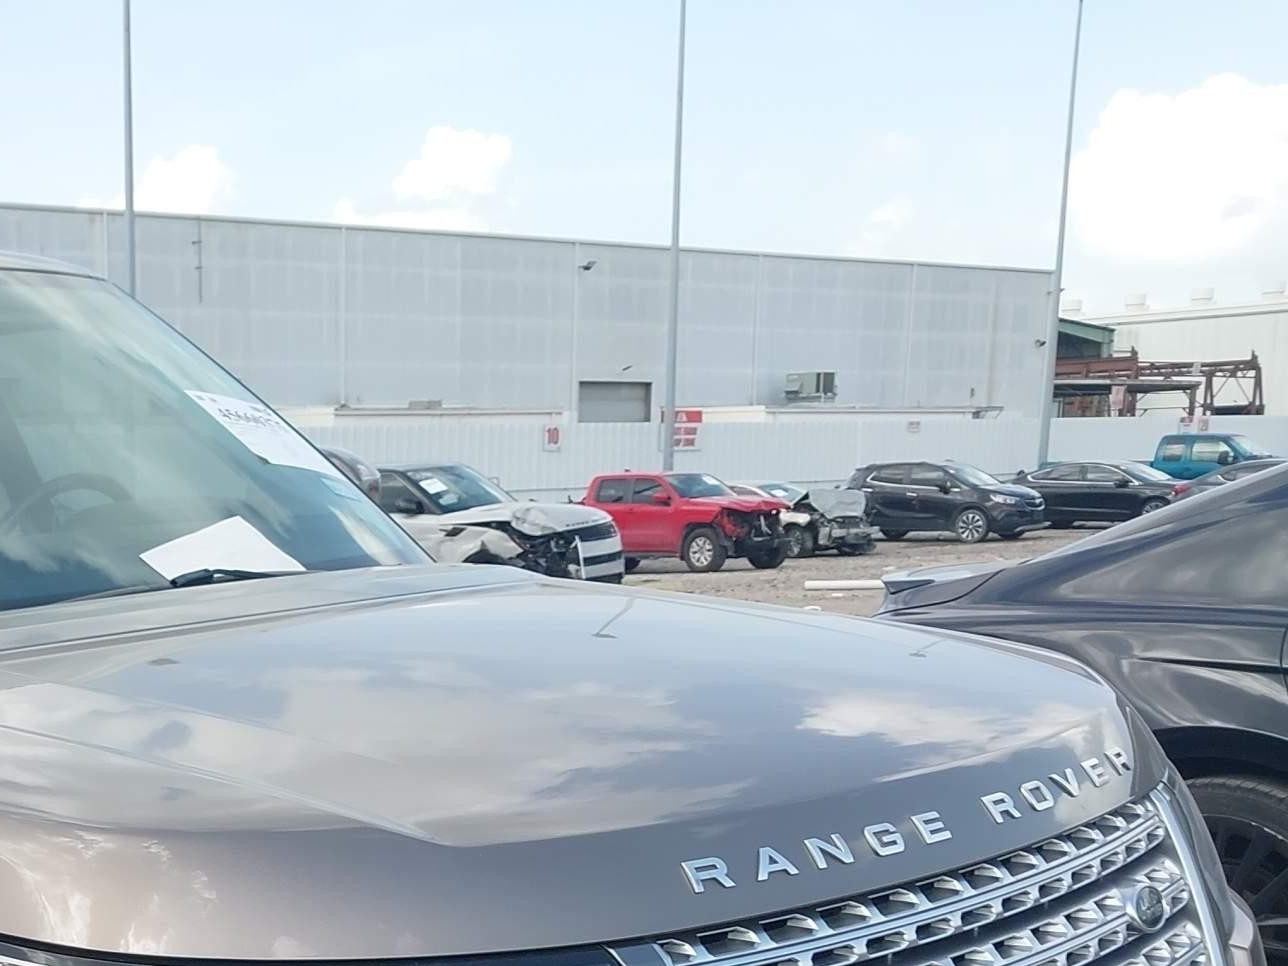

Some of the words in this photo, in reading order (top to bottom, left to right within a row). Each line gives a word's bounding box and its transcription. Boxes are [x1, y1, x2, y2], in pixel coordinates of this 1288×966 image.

[546, 427, 560, 445] 10
[680, 811, 953, 894] RANGE
[980, 747, 1132, 824] ROVER
